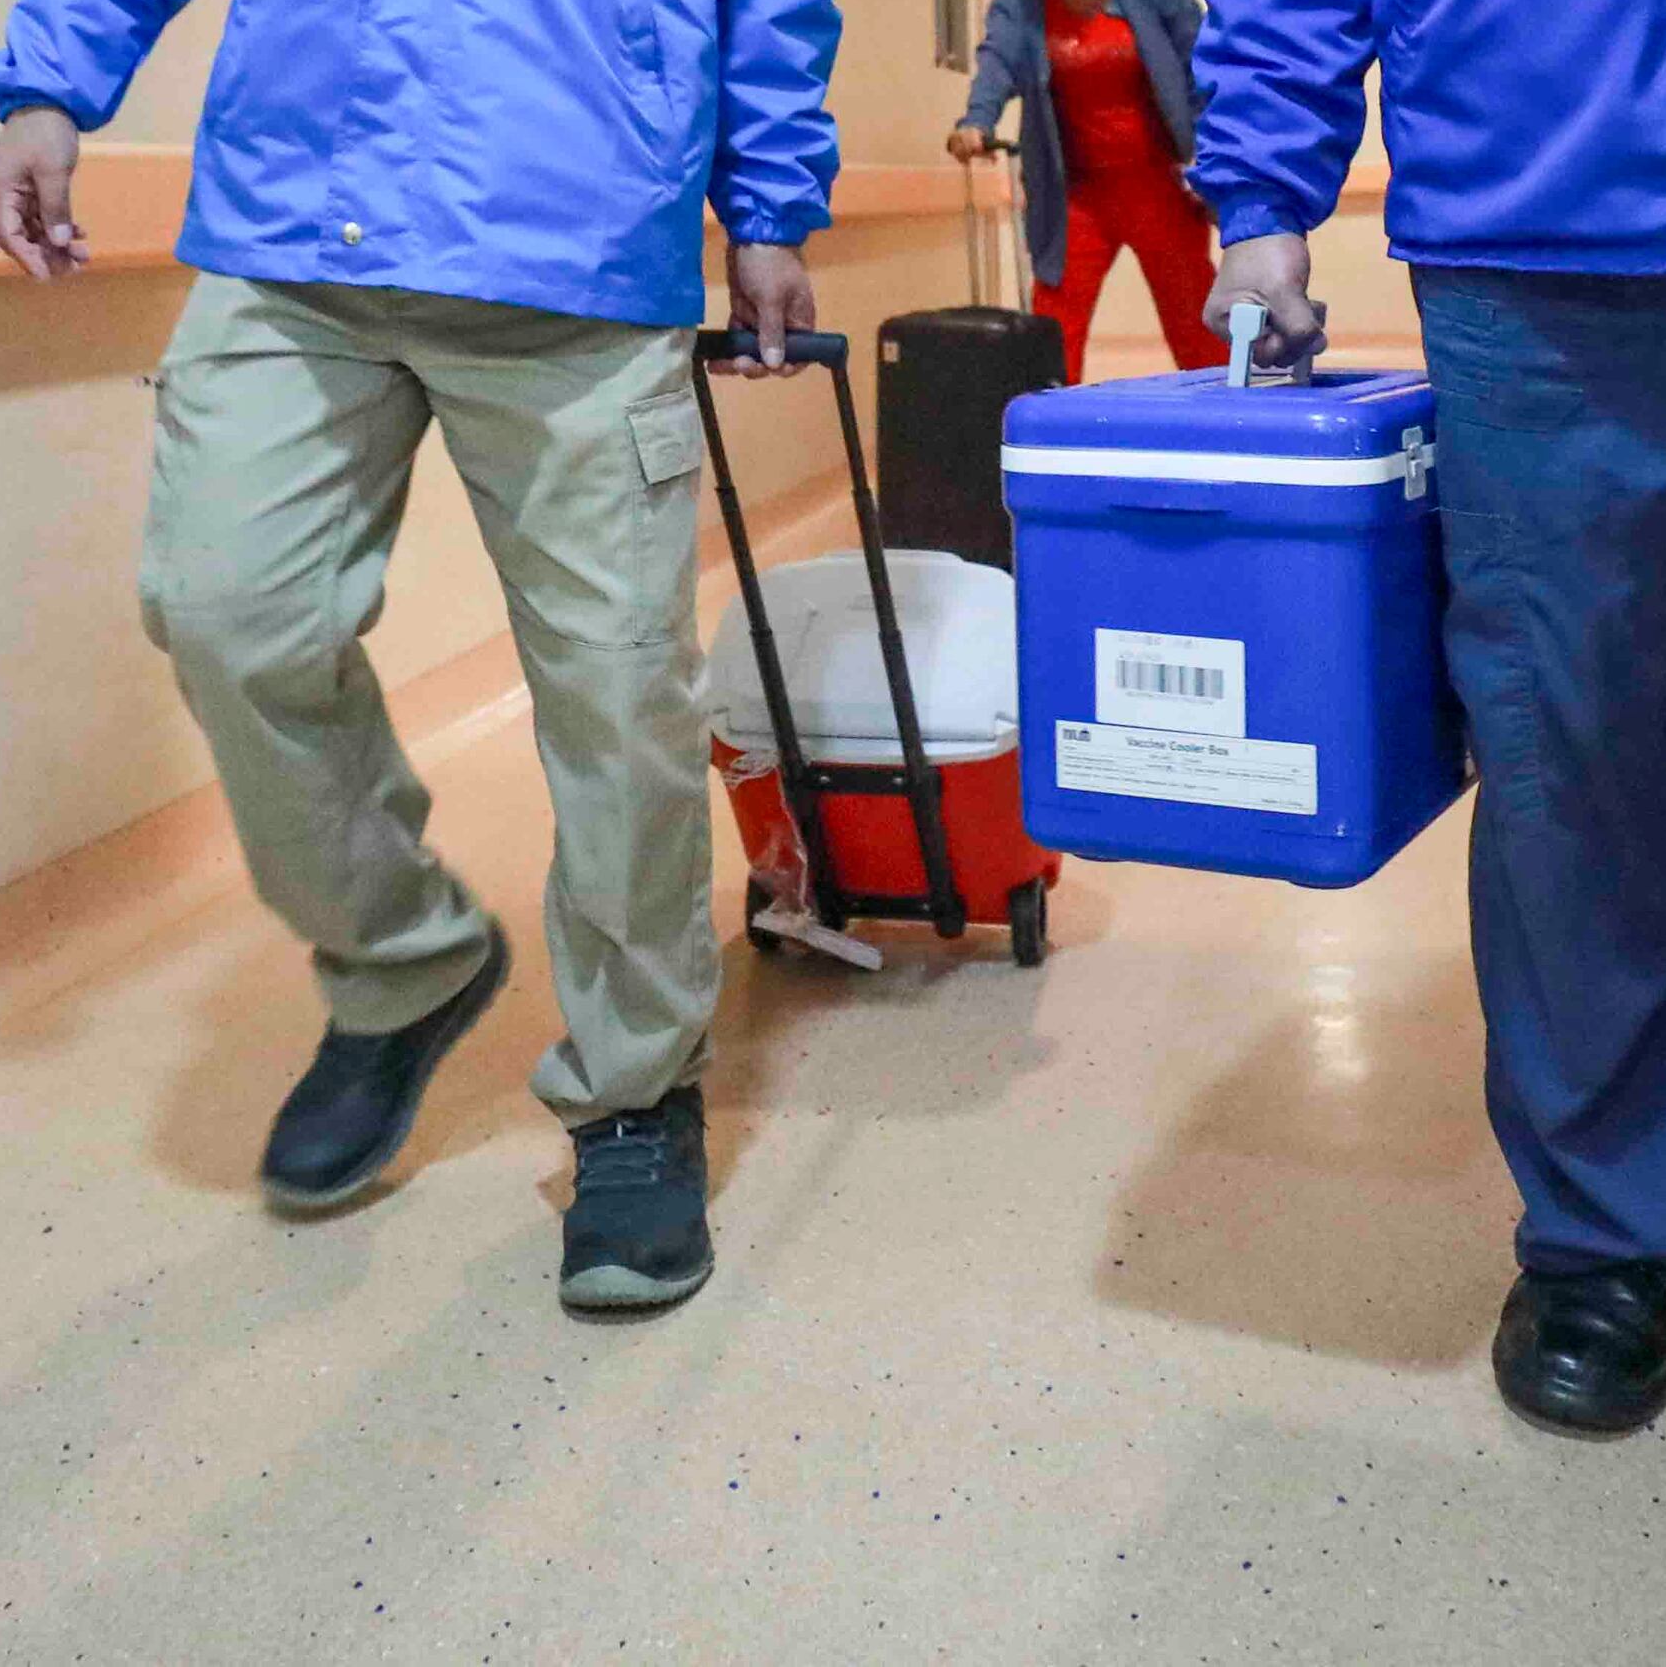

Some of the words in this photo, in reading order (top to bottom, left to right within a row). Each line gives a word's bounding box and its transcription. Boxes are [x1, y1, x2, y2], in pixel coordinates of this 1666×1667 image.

[1126, 736, 1167, 751] Vaccine
[1169, 740, 1206, 754] Cooler
[1208, 744, 1229, 756] Box
